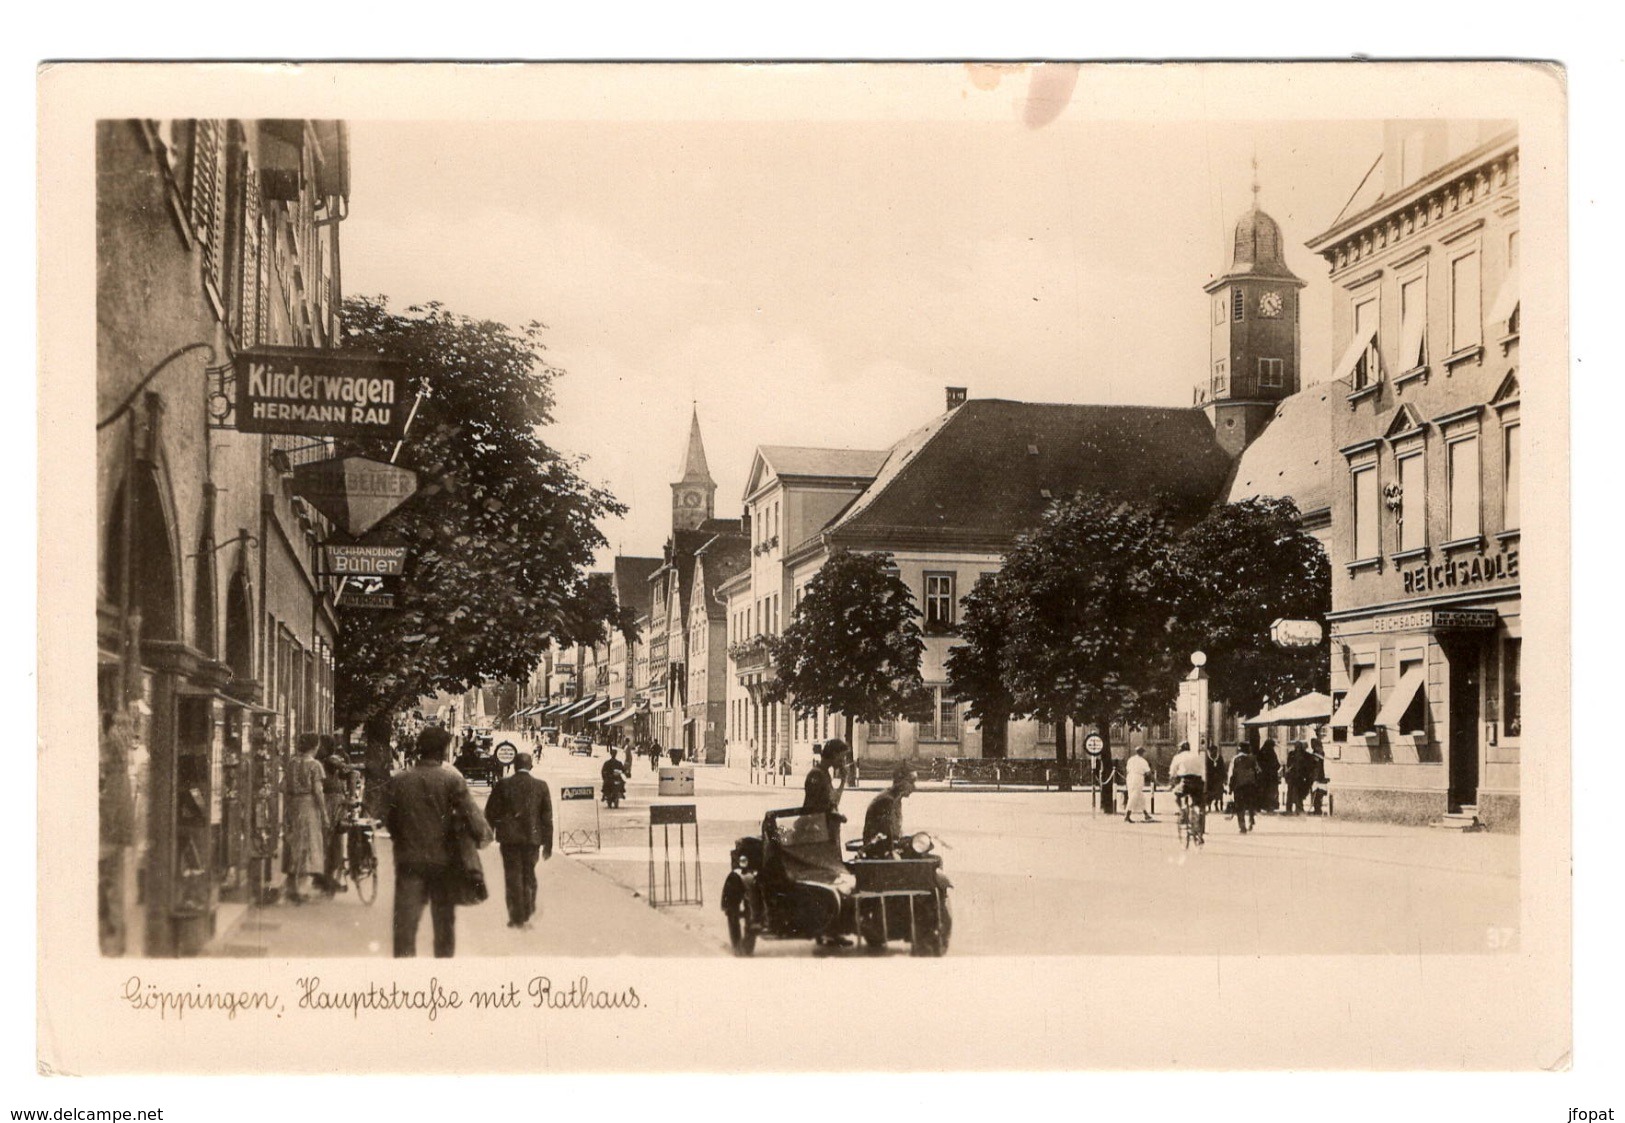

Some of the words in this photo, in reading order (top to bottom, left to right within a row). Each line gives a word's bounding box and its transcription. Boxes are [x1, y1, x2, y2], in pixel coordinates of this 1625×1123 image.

[249, 363, 394, 407] Kinderwagen
[253, 402, 346, 423] HERMANN
[351, 407, 391, 425] RAU
[327, 545, 403, 558] TUCHHANDLUNG
[334, 556, 398, 573] Bühler
[1374, 613, 1431, 632] REICHSADLER
